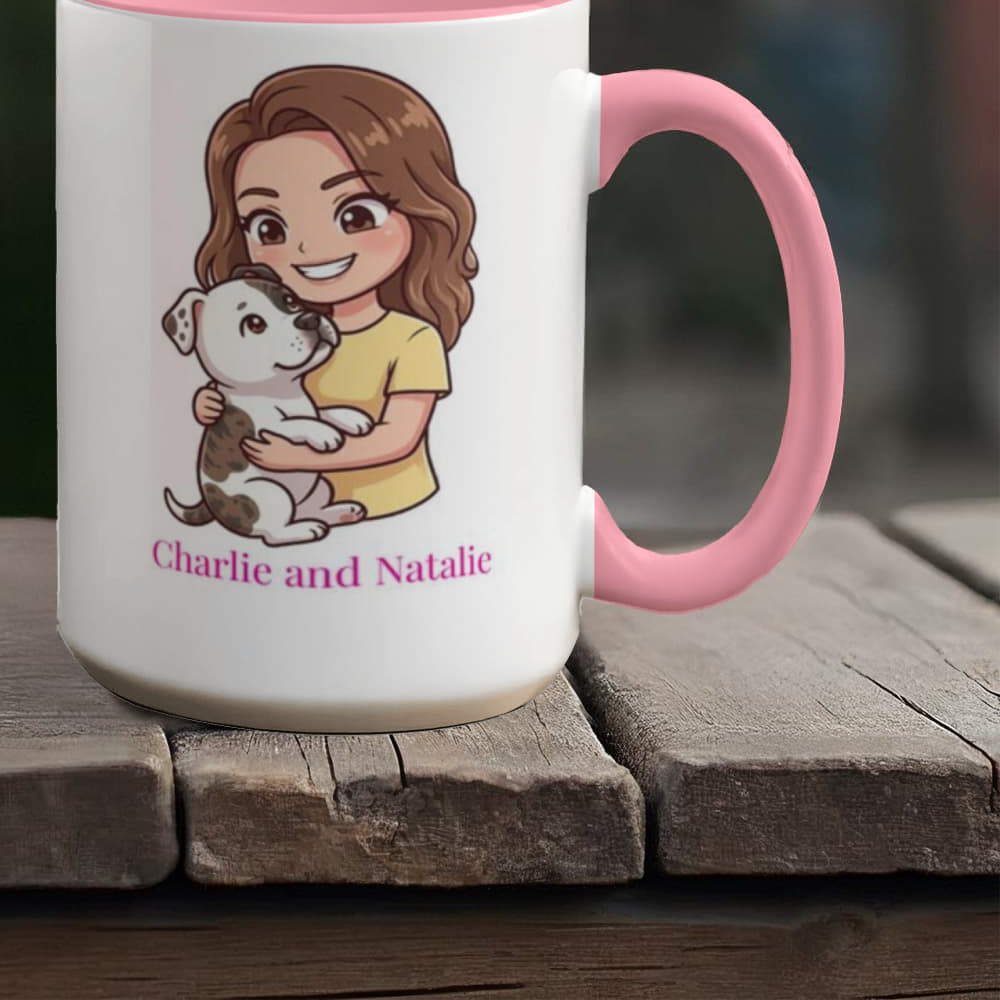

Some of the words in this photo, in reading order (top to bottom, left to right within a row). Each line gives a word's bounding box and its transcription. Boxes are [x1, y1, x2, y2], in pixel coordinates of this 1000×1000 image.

[151, 540, 273, 587] Charlie
[283, 556, 362, 590] and
[376, 545, 493, 585] Natalie
